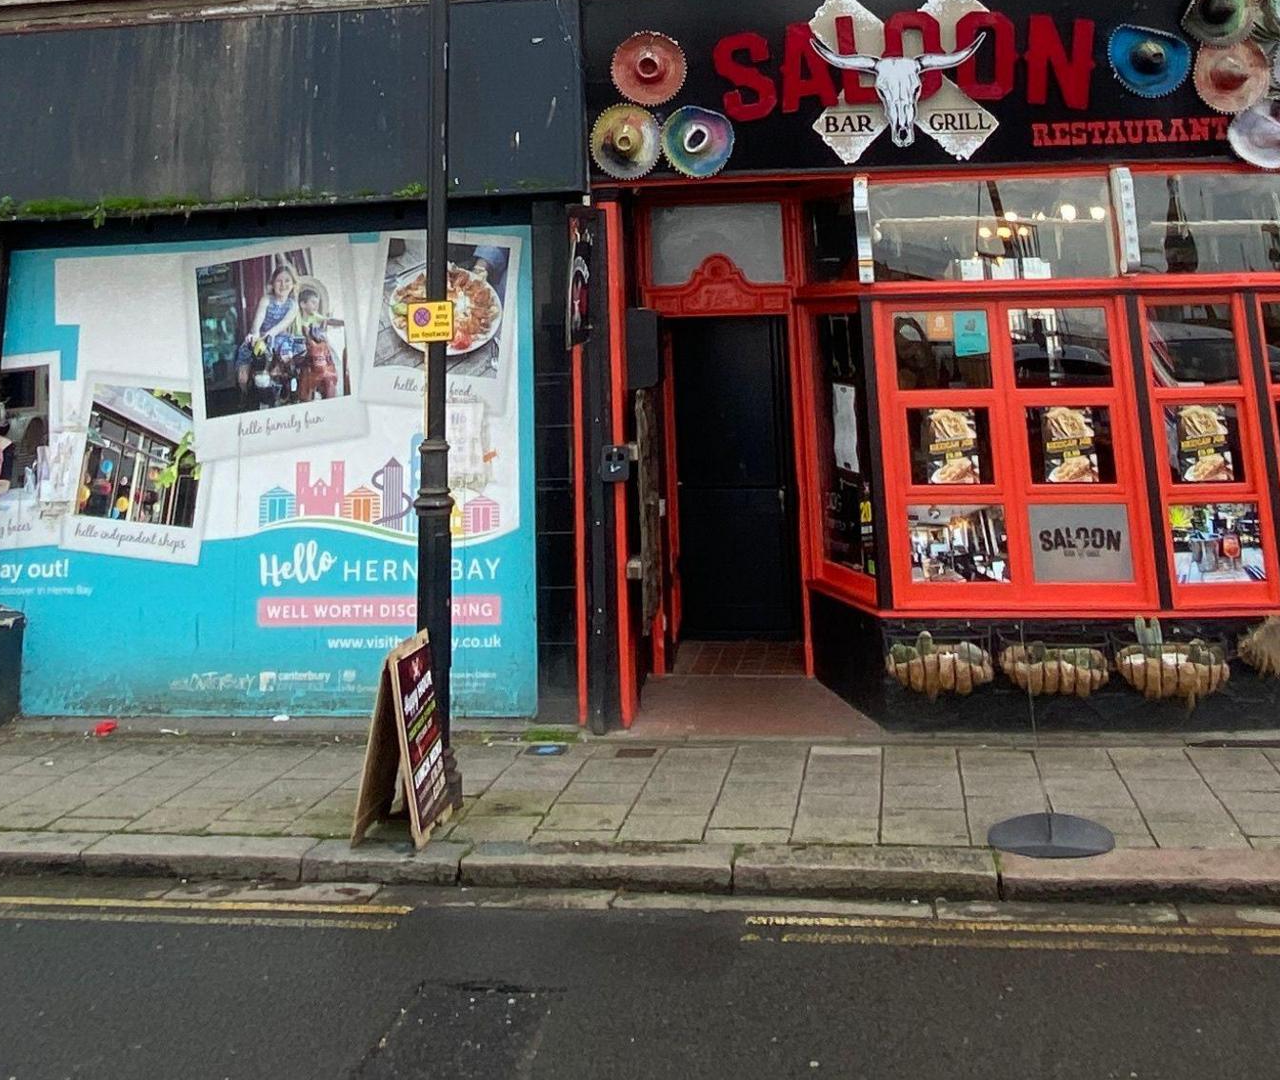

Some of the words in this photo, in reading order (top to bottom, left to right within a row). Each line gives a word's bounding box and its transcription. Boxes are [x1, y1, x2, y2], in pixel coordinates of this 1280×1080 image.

[713, 11, 1095, 120] SALOON
[824, 115, 874, 134] BAR
[929, 112, 993, 132] GRILL
[1031, 116, 1229, 148] RESTAURANT
[393, 375, 418, 392] hello
[238, 421, 262, 438] hello
[265, 414, 302, 436] family
[75, 523, 98, 538] hello
[100, 528, 157, 547] independent
[158, 533, 186, 554] shops
[1039, 526, 1121, 552] SALOON
[28, 558, 69, 578] out!
[259, 540, 337, 587] Hello
[343, 559, 418, 582] HERN
[267, 605, 309, 619] WELL
[314, 604, 374, 618] WORTH
[380, 603, 493, 618] DISCRING
